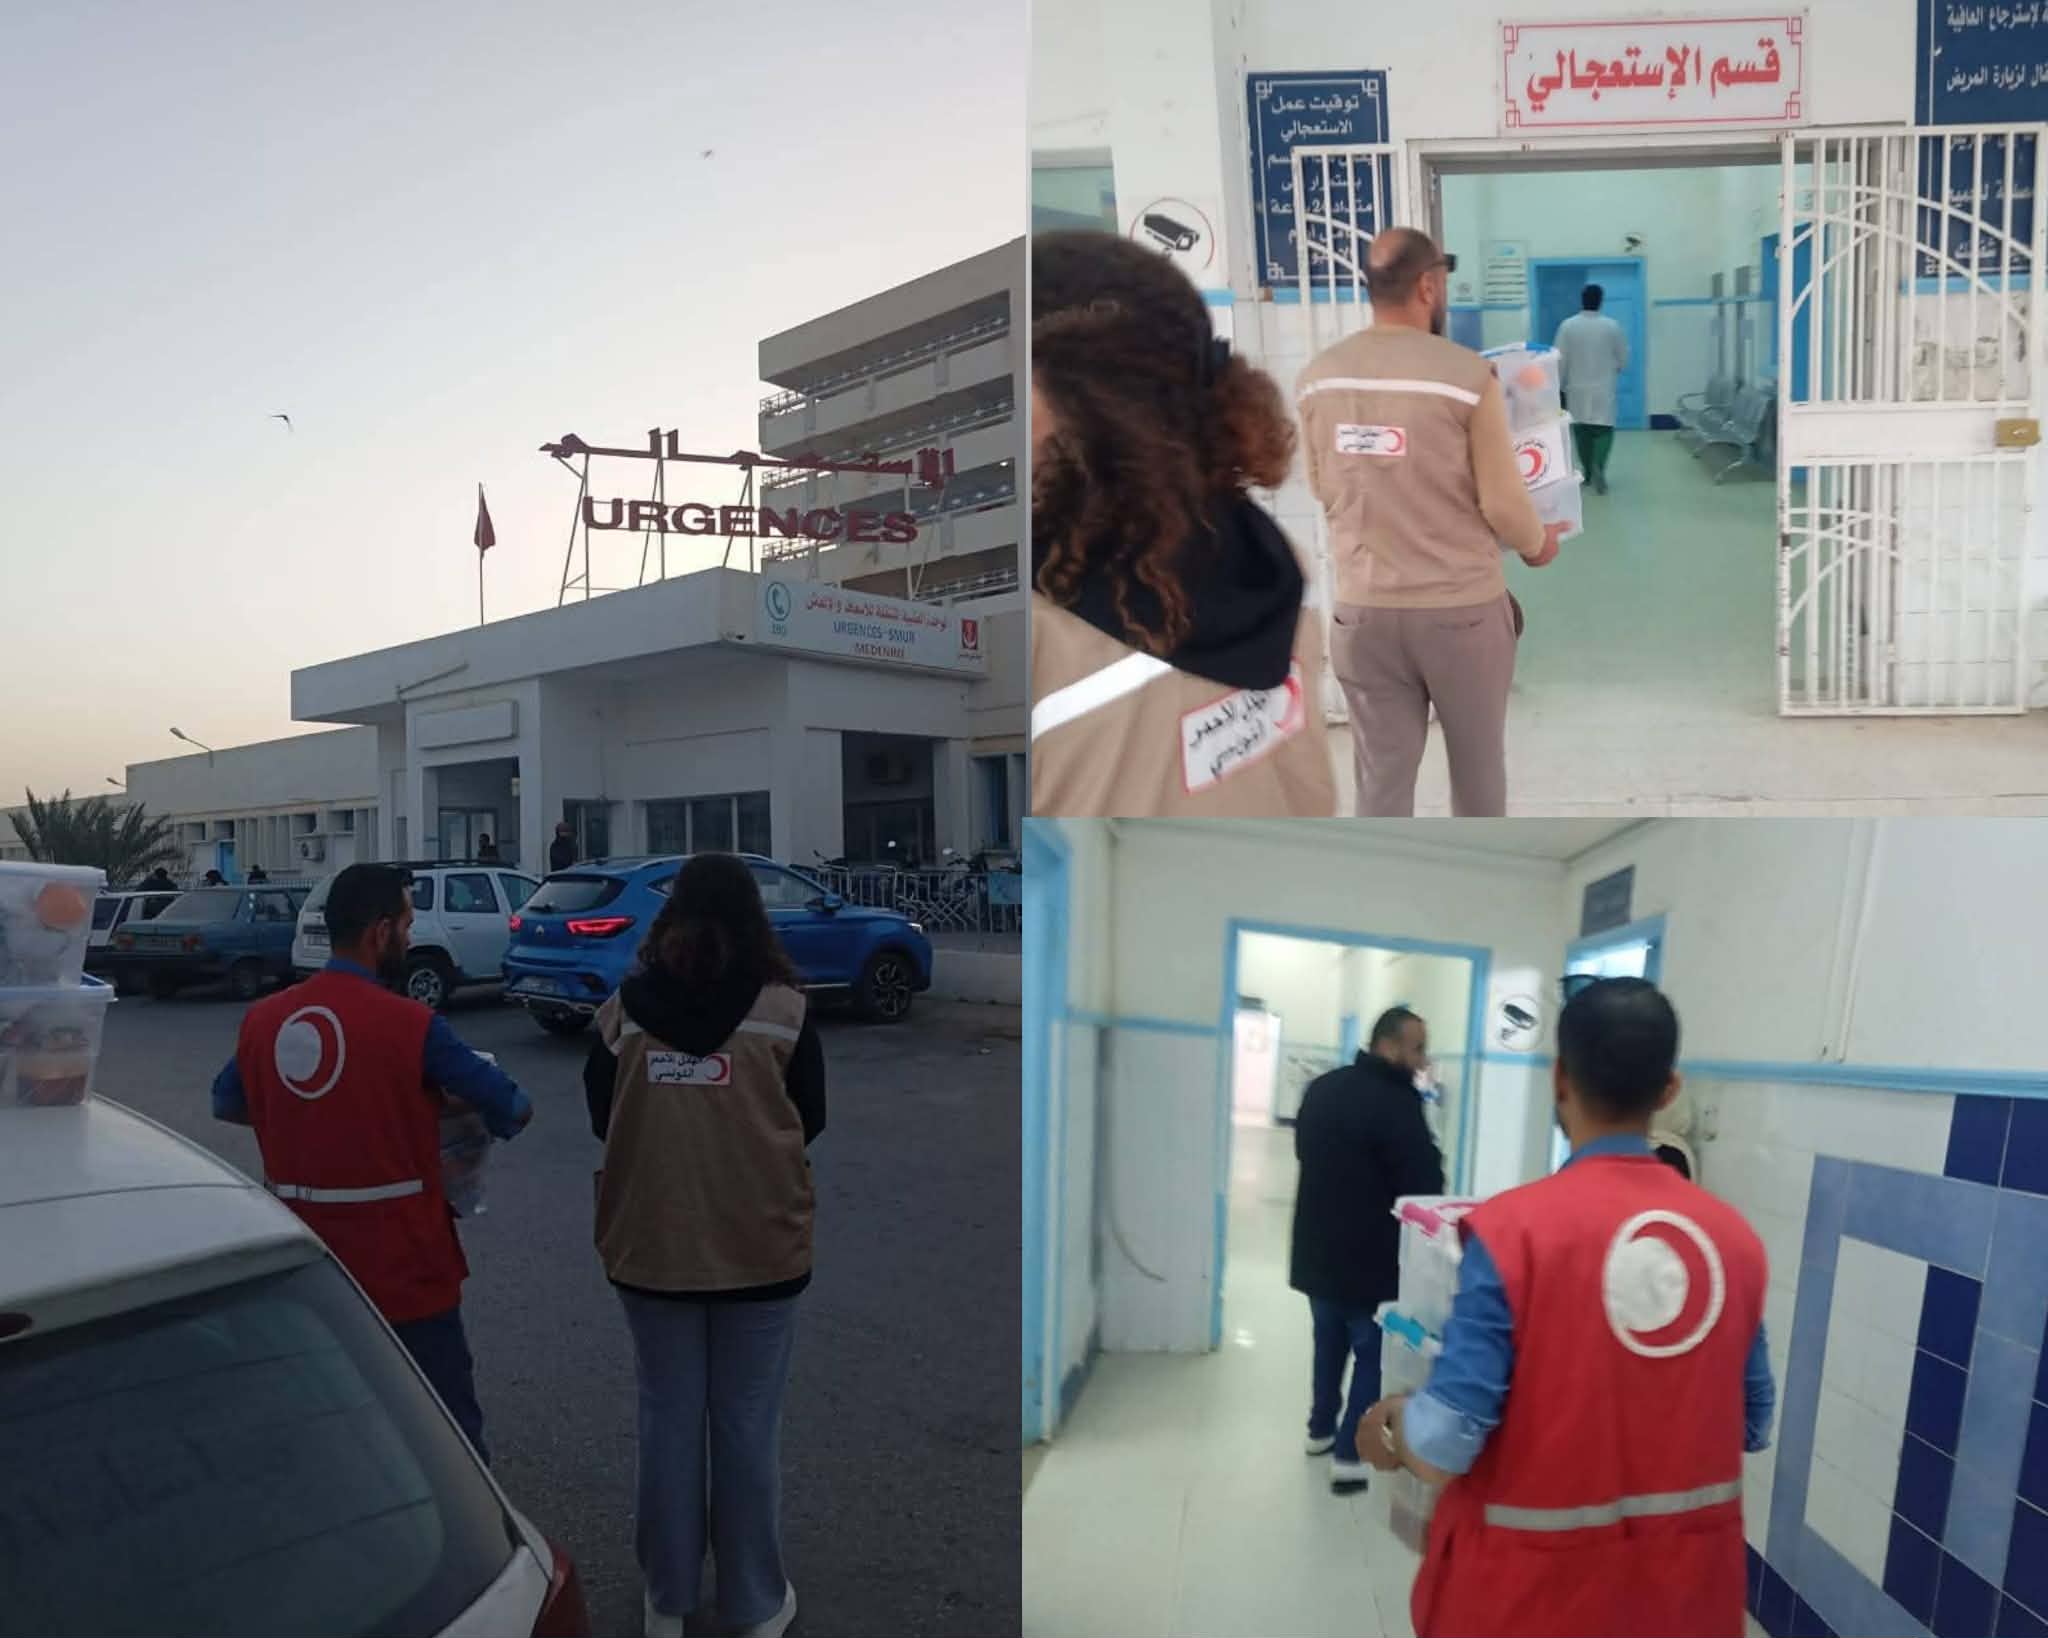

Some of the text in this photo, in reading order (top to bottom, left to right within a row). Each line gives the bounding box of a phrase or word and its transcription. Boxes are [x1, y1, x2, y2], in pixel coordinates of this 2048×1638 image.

[1946, 3, 1984, 33] العافية
[1526, 37, 1781, 112] قسم الإستعجالي
[1272, 94, 1360, 114] توقيت عمل
[582, 496, 919, 543] URGENCES
